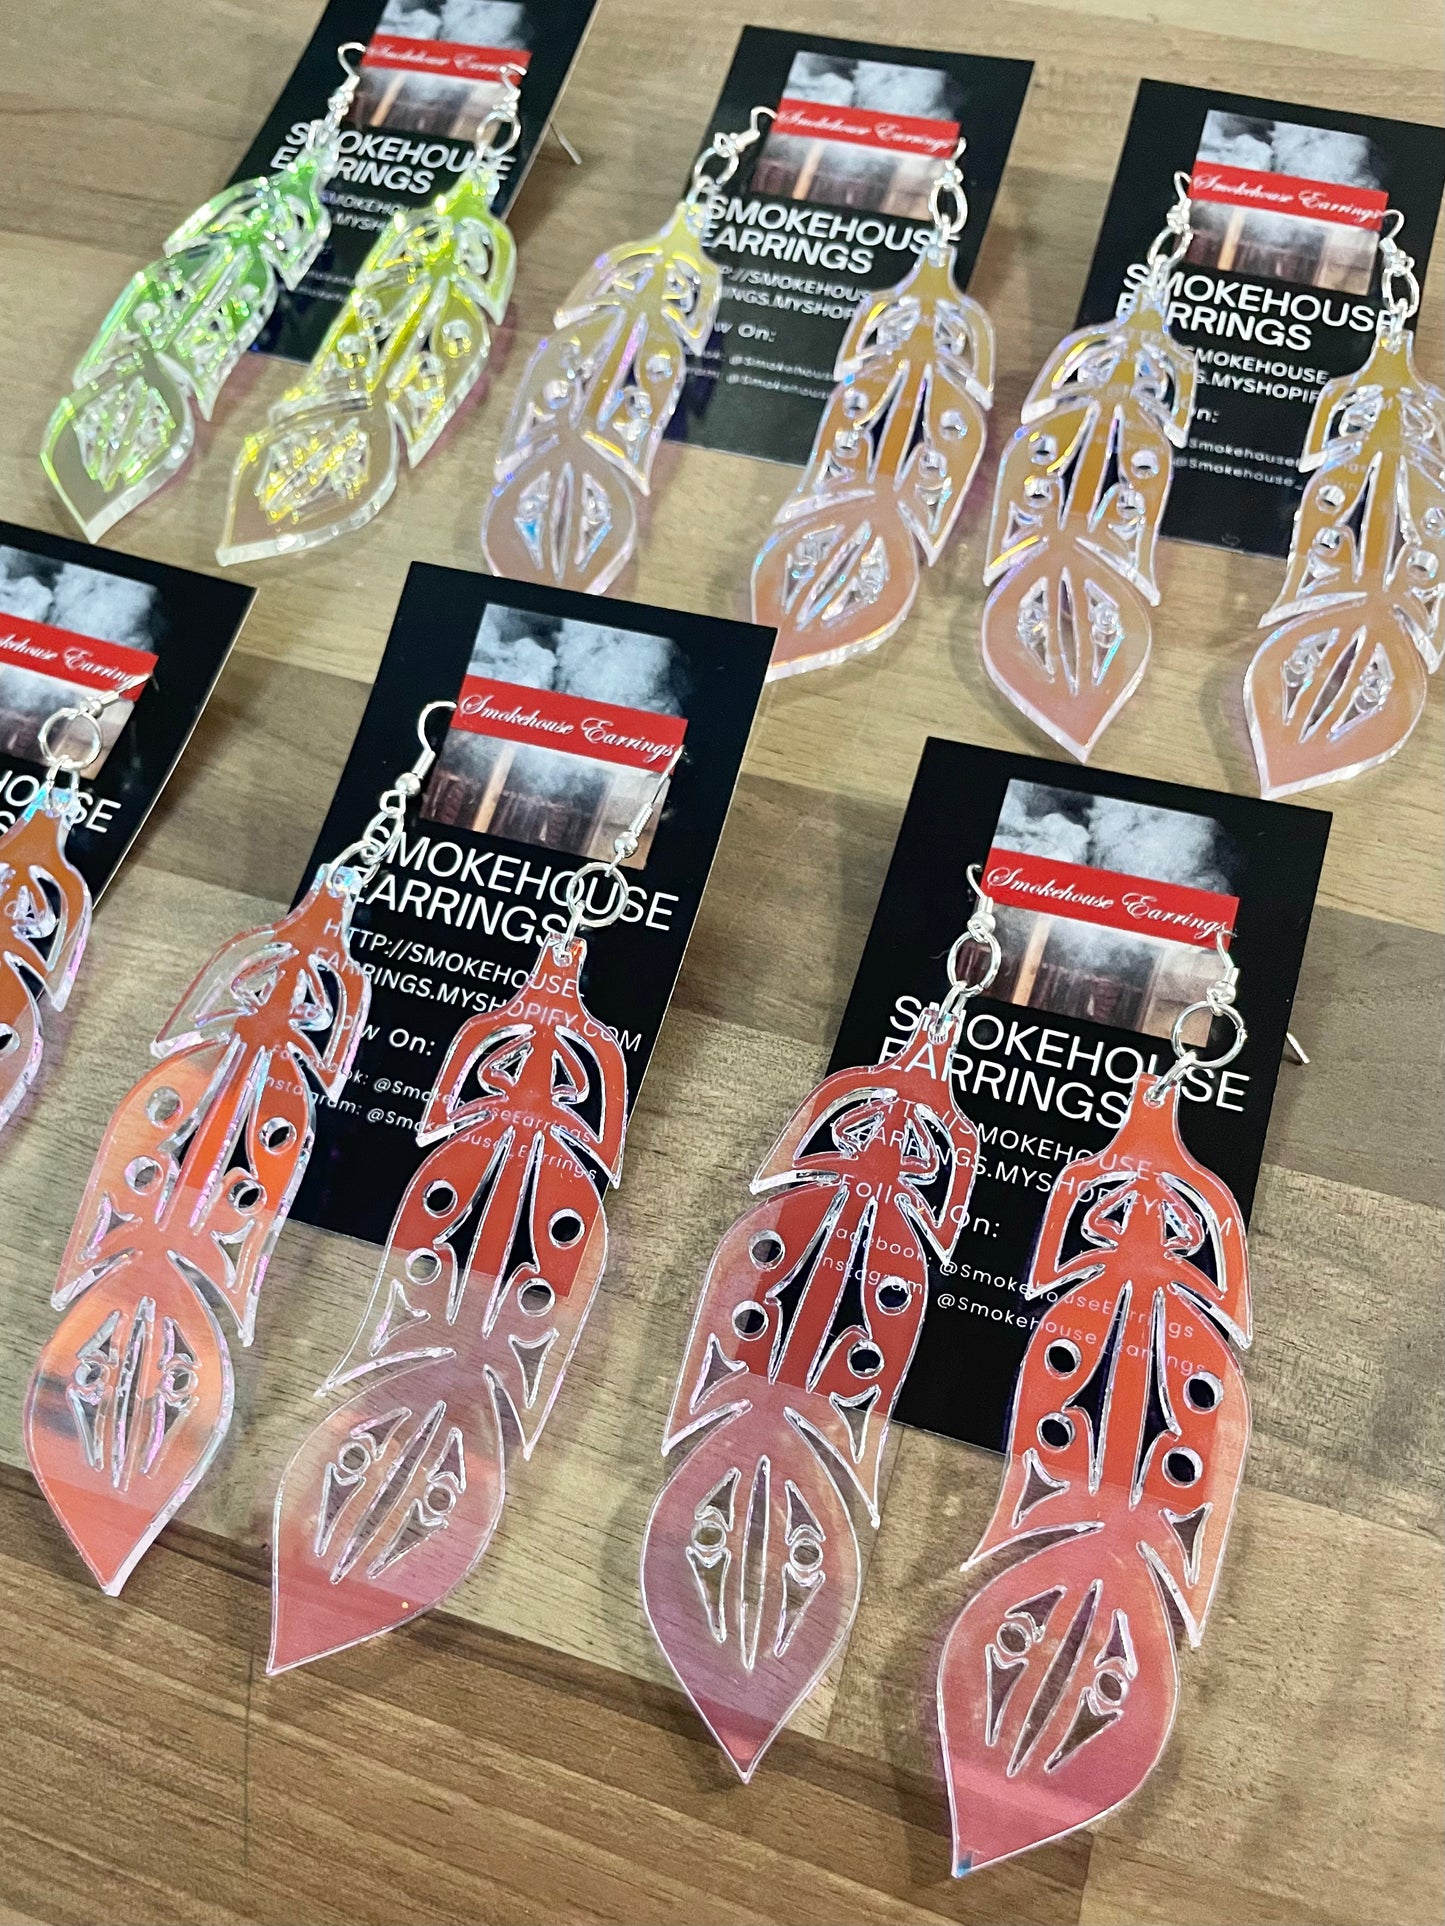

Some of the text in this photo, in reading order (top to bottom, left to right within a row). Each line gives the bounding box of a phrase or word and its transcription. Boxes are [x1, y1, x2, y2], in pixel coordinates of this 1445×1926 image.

[269, 145, 435, 194] ERINGS
[706, 195, 962, 255] SMOKEHOUS
[1115, 292, 1313, 351] ERRINGS
[460, 694, 675, 763] Smokehouse Earrings
[986, 867, 1227, 940] Smokehouse Earrings
[388, 1028, 436, 1056] On:
[950, 1203, 1001, 1238] On:
